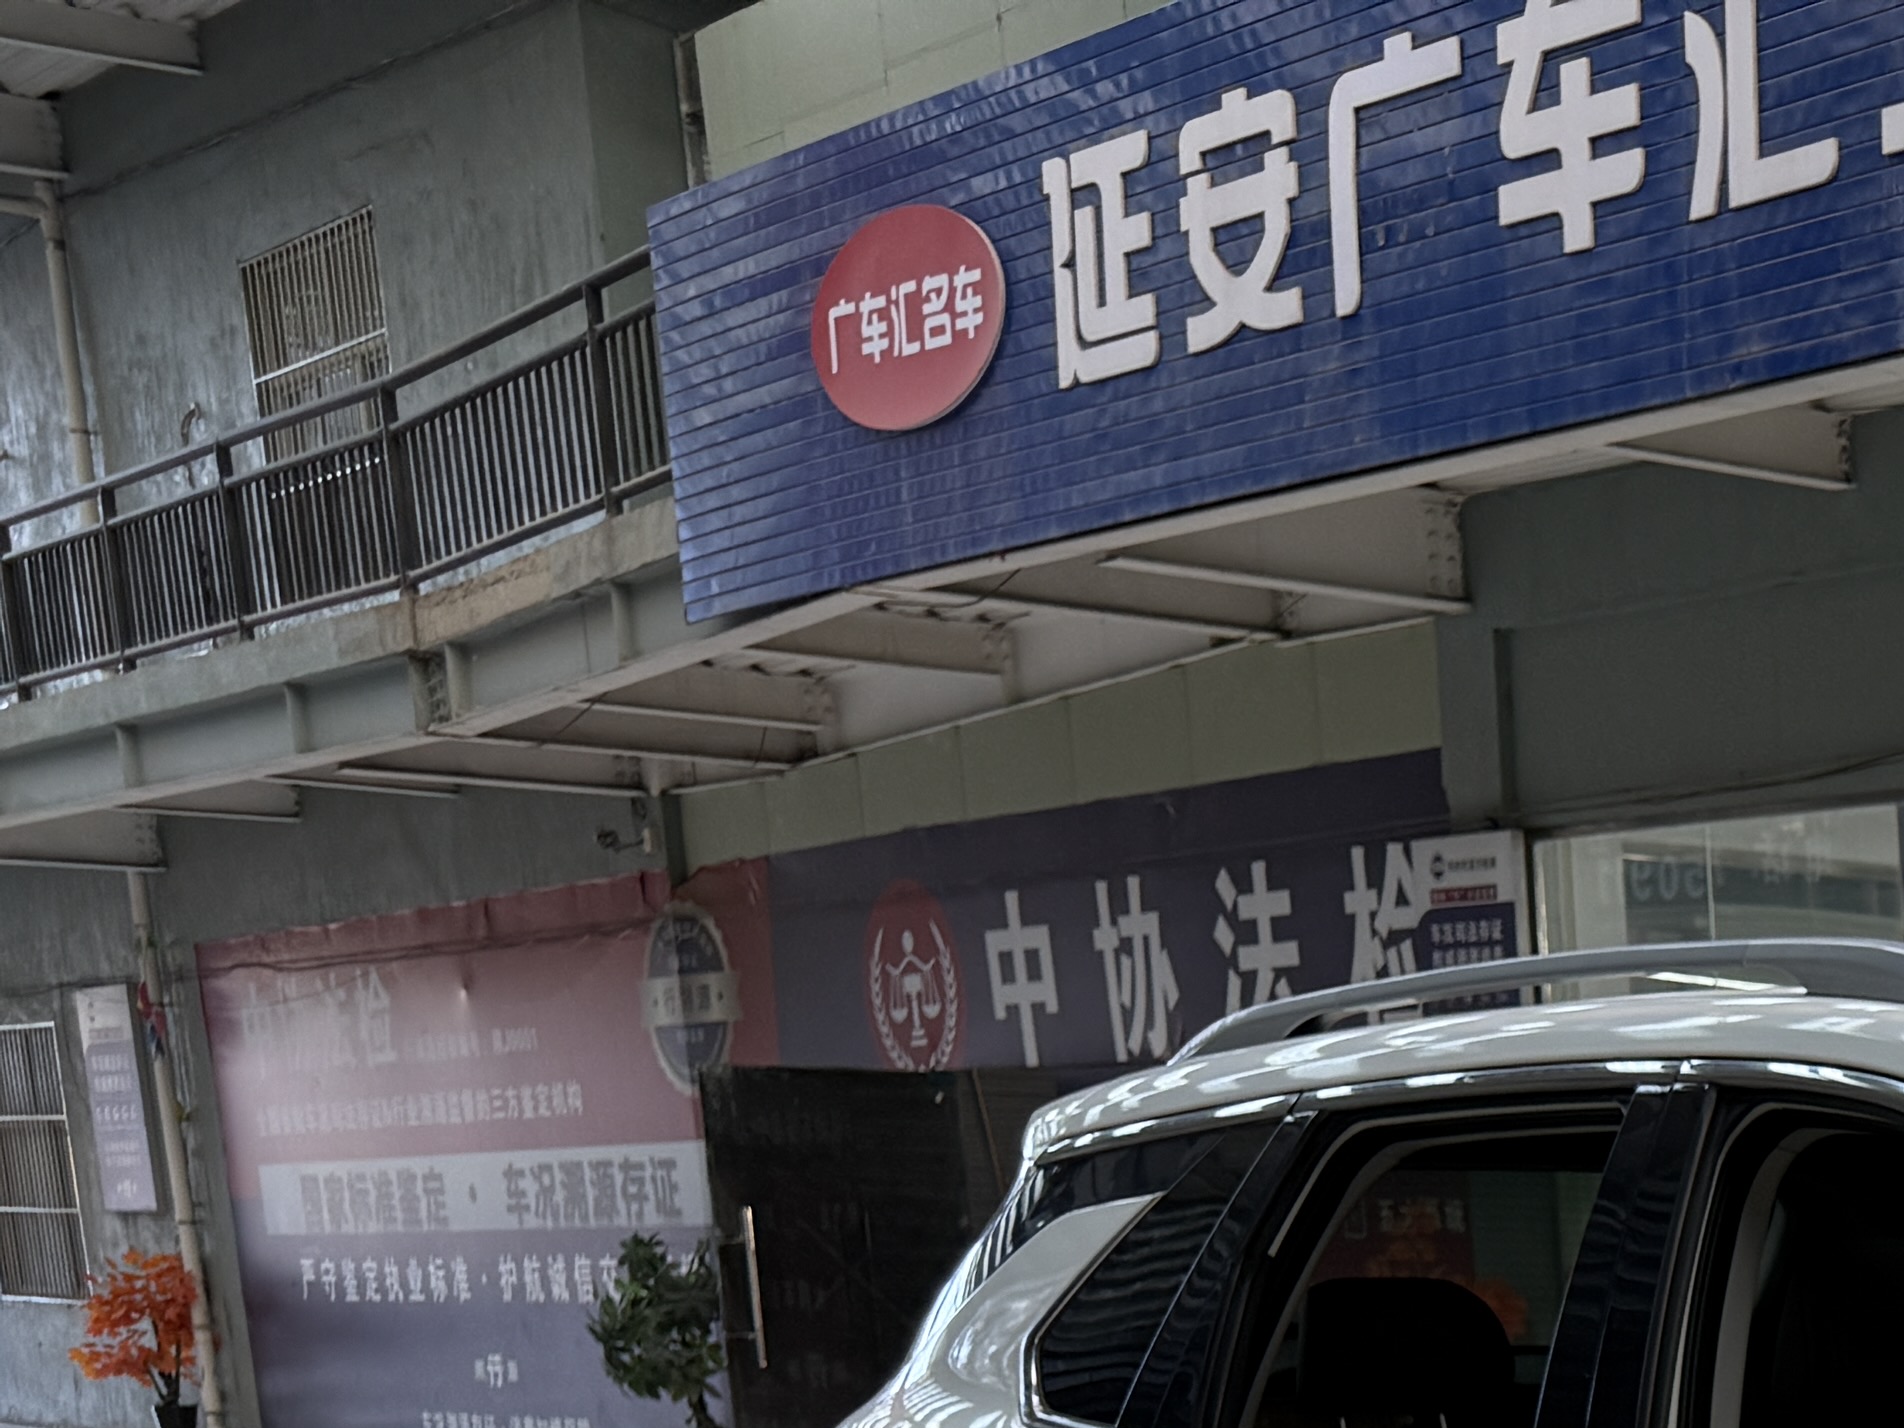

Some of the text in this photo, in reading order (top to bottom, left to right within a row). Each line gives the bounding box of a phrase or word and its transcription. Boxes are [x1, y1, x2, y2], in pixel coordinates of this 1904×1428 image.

[826, 264, 986, 375] 广车汇名车
[985, 842, 1421, 1068] 中协法检
